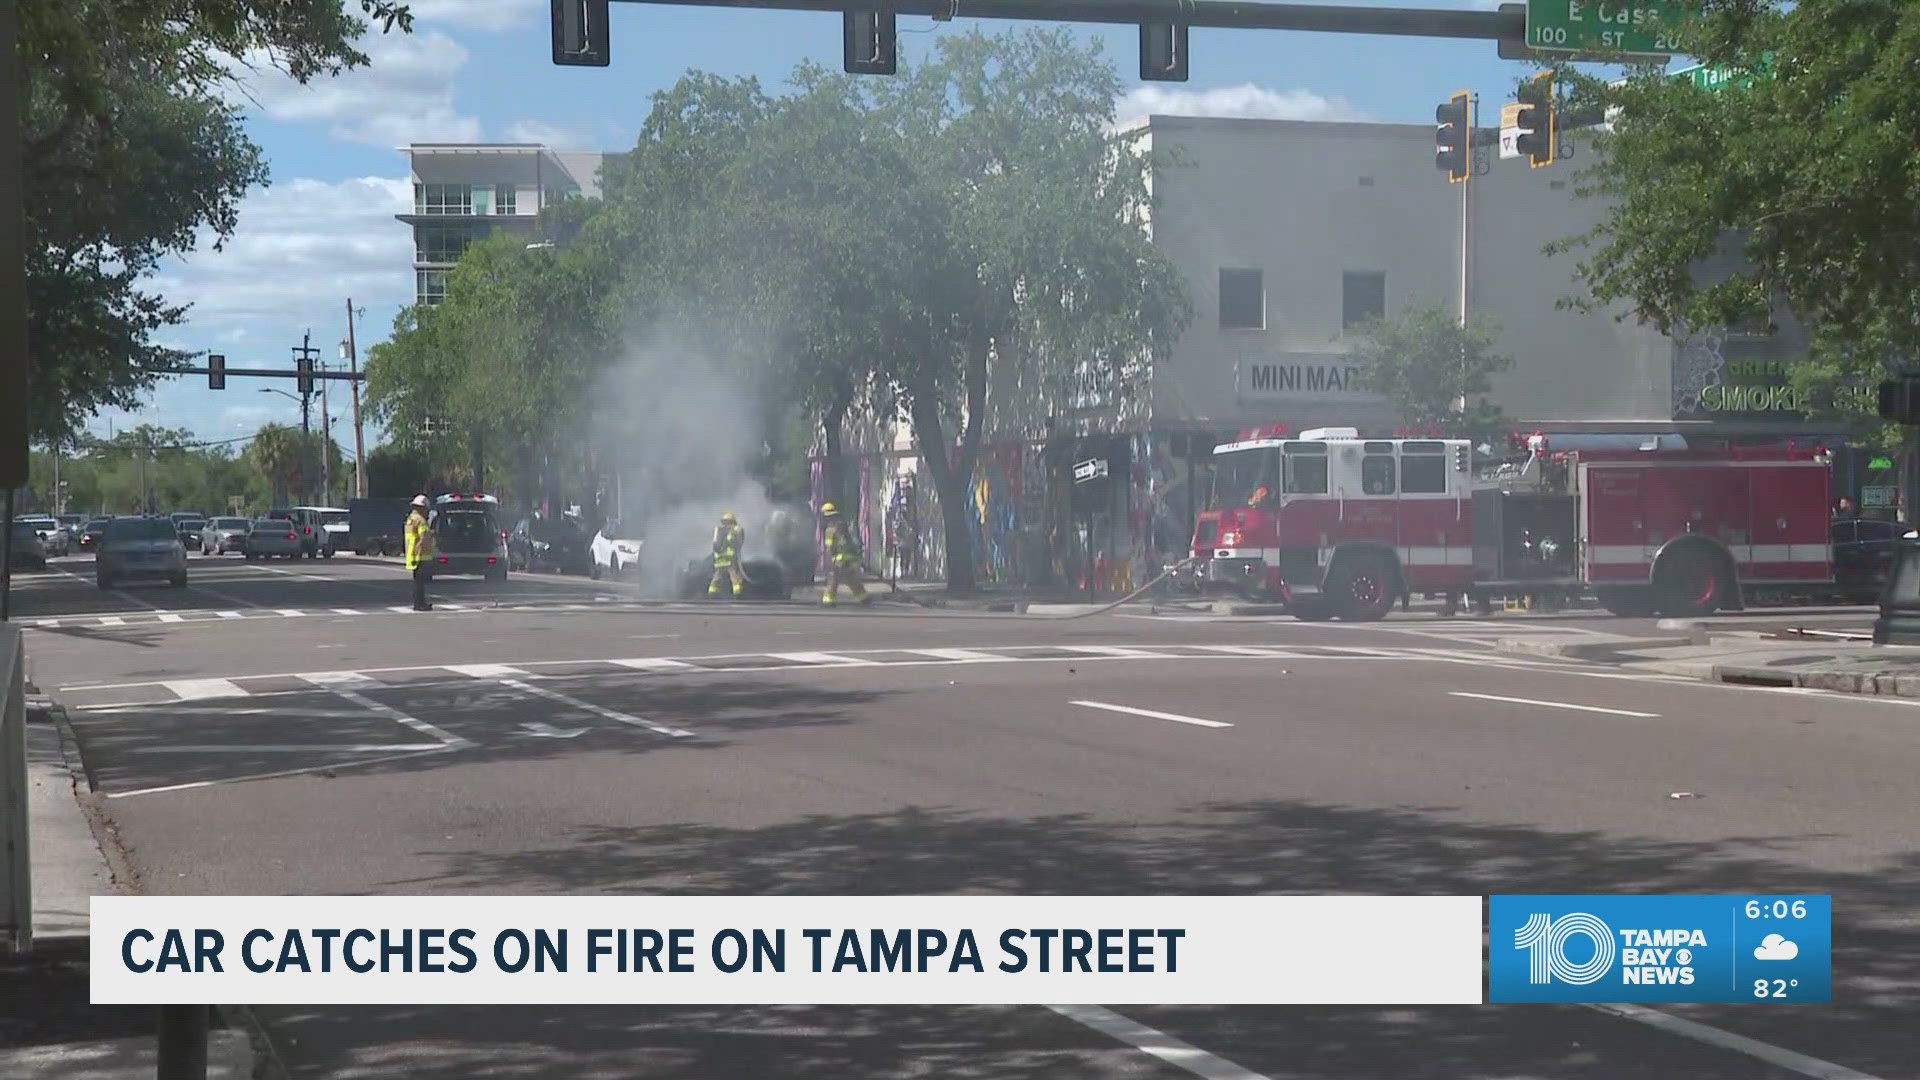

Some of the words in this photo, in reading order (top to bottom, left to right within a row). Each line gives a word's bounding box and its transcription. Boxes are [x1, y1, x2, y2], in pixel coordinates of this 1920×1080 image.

[1568, 0, 1583, 22] E
[1535, 27, 1567, 45] 100
[1602, 31, 1625, 48] ST
[1654, 33, 1691, 50] 20
[1251, 365, 1302, 392] MINI
